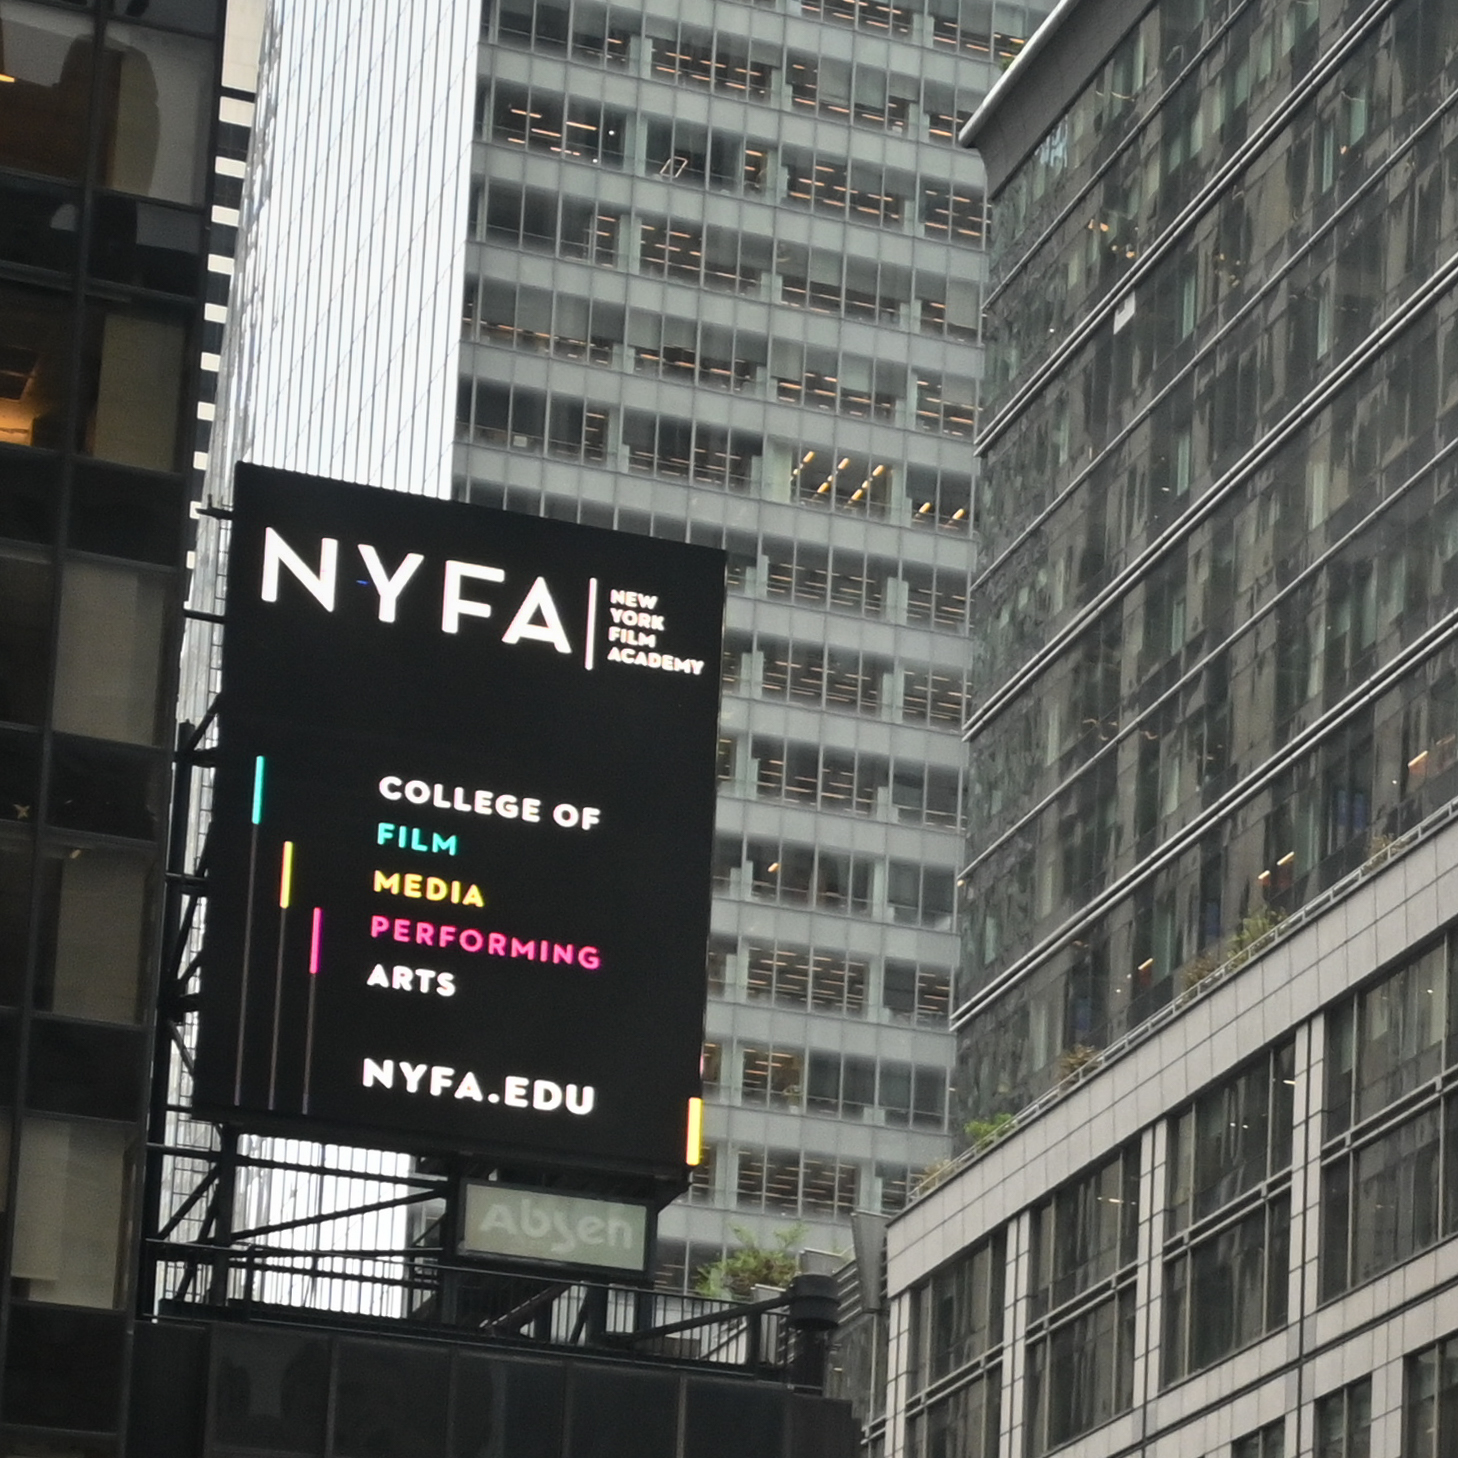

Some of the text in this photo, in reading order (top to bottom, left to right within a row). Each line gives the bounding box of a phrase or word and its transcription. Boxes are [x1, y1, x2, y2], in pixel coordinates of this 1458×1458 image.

[261, 526, 573, 655] NYFA
[610, 589, 658, 610] NEW
[609, 607, 665, 631] YORK
[608, 626, 656, 648] FILM
[607, 646, 705, 676] ACADEMY
[378, 775, 601, 830] COLLEGE OF
[377, 823, 457, 856] FILM
[373, 870, 484, 907] MEDIA
[370, 916, 600, 970] PERFORMING
[367, 963, 456, 997] ARTS
[362, 1058, 595, 1116] NYFA.EDU
